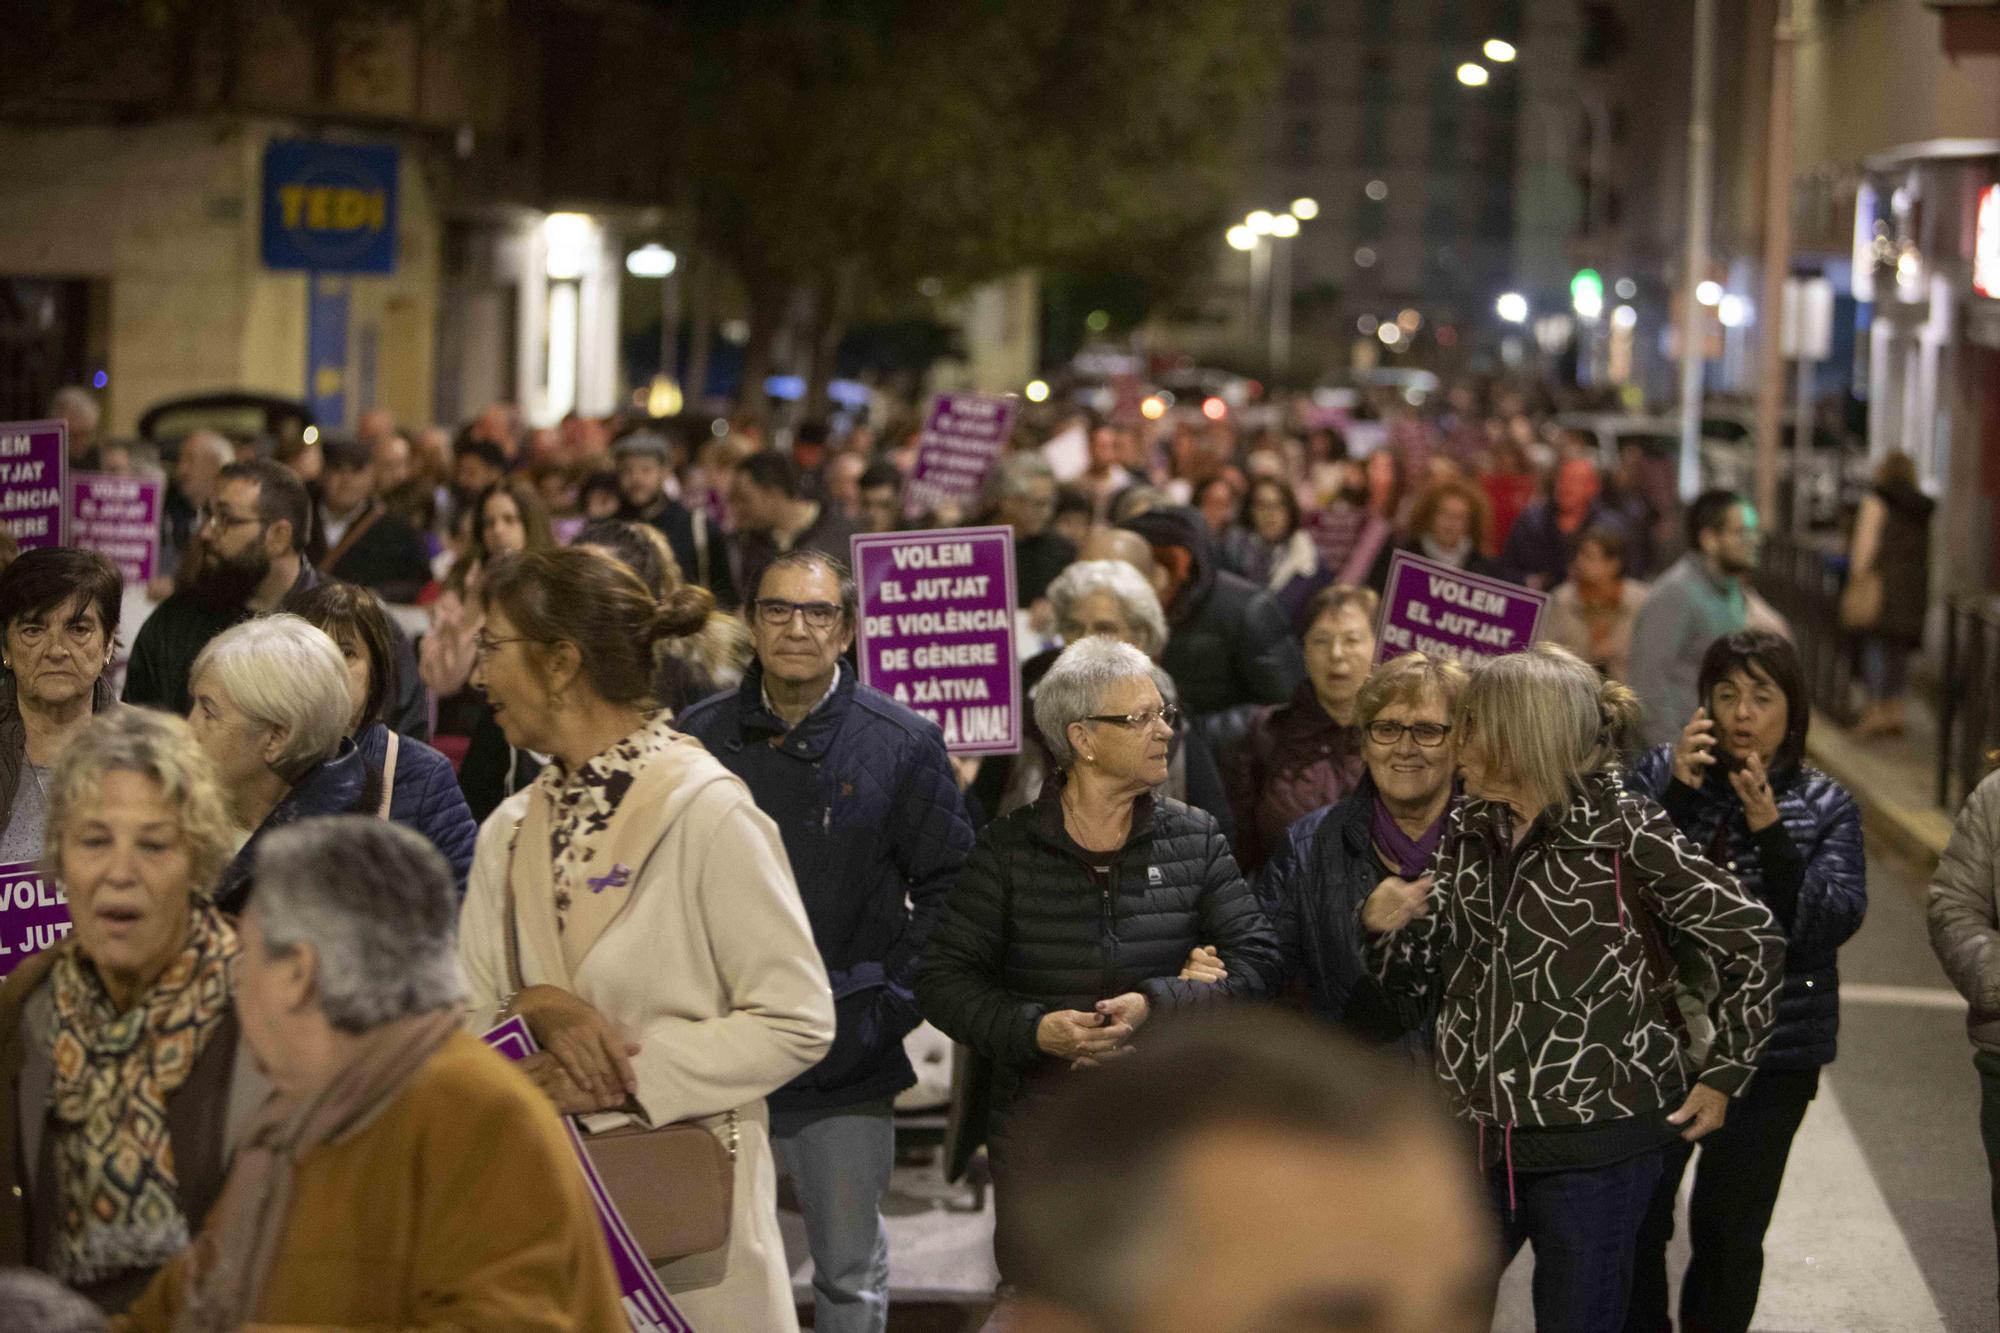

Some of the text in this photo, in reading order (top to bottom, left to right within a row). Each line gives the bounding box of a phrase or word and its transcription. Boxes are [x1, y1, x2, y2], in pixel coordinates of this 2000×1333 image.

[892, 543, 973, 570] VOLEM
[880, 576, 989, 603] EL JUTJAT
[1429, 576, 1506, 616] VOLEM
[864, 607, 1009, 638] DE VIOLÈNCIA
[1384, 624, 1412, 649] DE
[1406, 600, 1514, 648] EL JUTJAT
[880, 642, 997, 670] DE GÈNERE
[894, 677, 989, 703] A XÀTIVA
[944, 708, 959, 743] A
[962, 705, 1010, 743] UNA!
